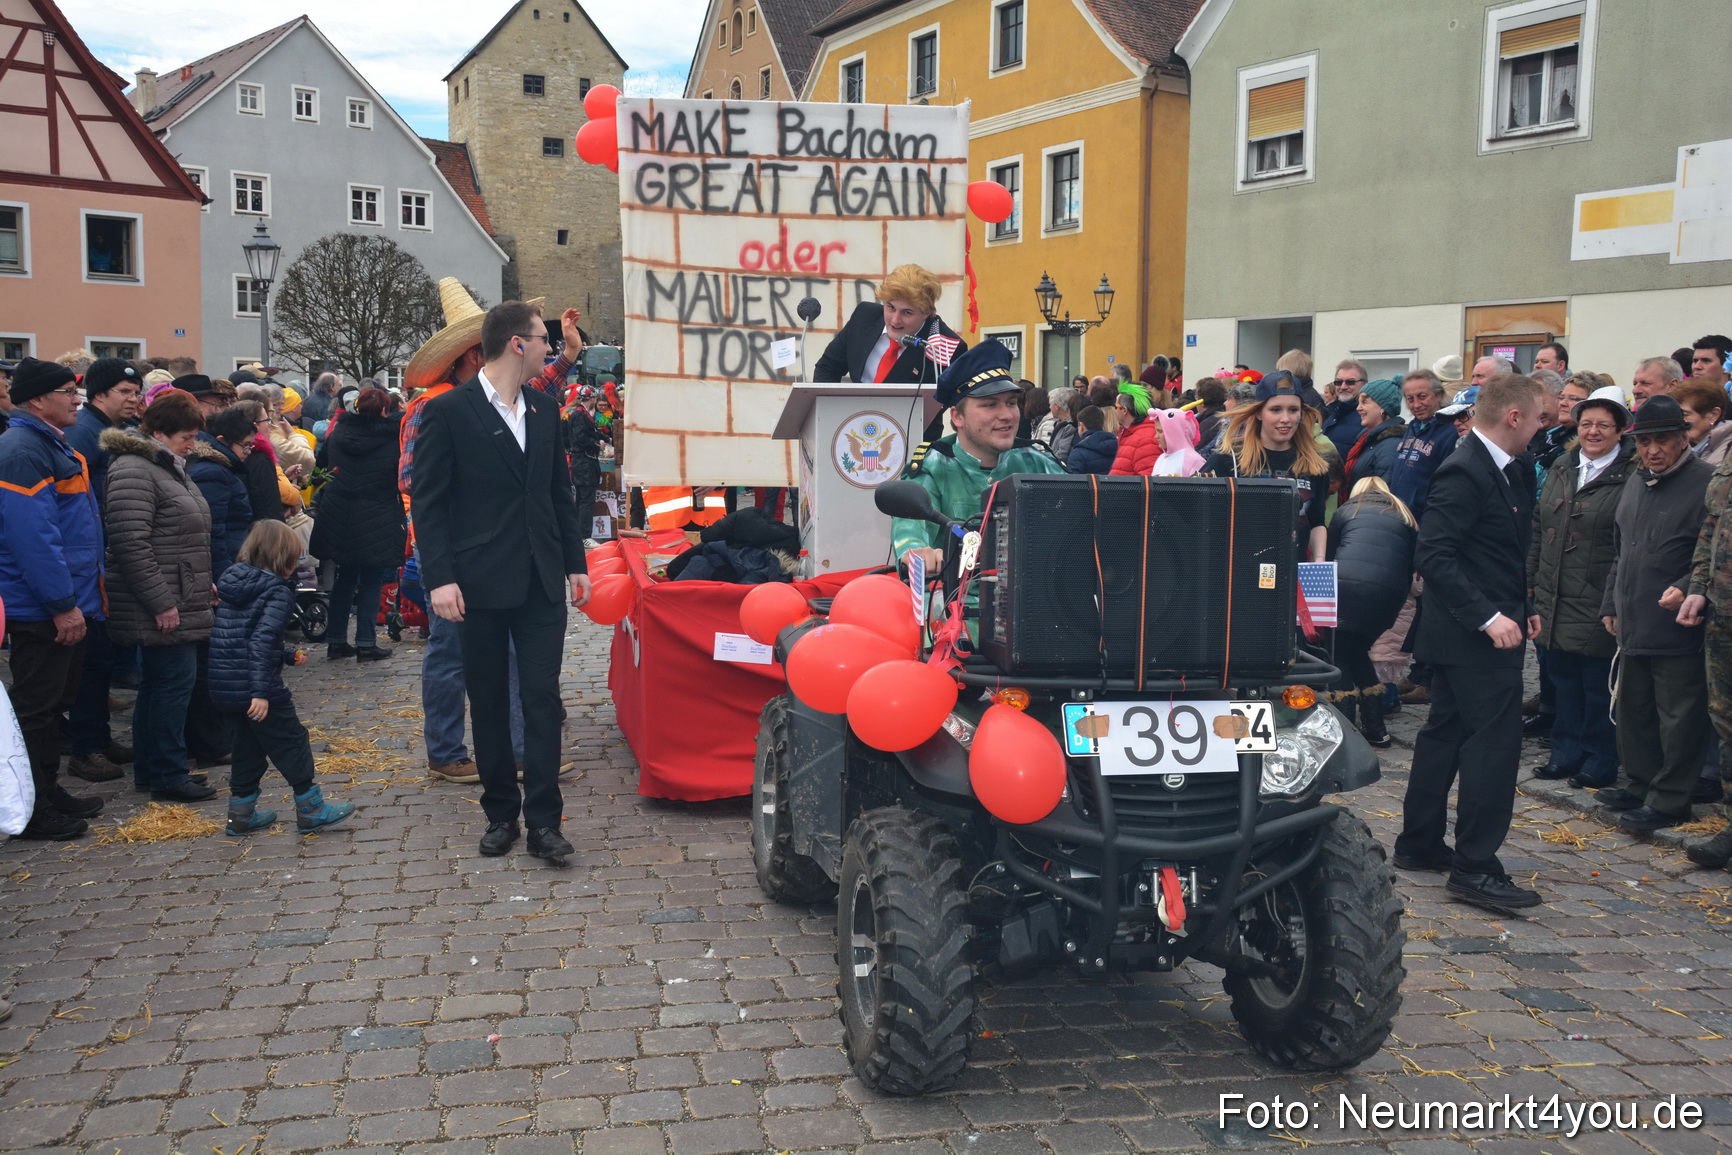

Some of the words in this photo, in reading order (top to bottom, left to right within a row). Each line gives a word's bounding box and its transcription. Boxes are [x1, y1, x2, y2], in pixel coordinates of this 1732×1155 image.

[631, 107, 750, 157] MAKE
[777, 107, 938, 161] Bacham
[634, 162, 799, 215] GREAT
[810, 164, 948, 218] AGAIN
[738, 222, 848, 275] oder
[645, 269, 831, 330] MAUERT
[1074, 734, 1083, 746] D
[1122, 704, 1208, 768] 39
